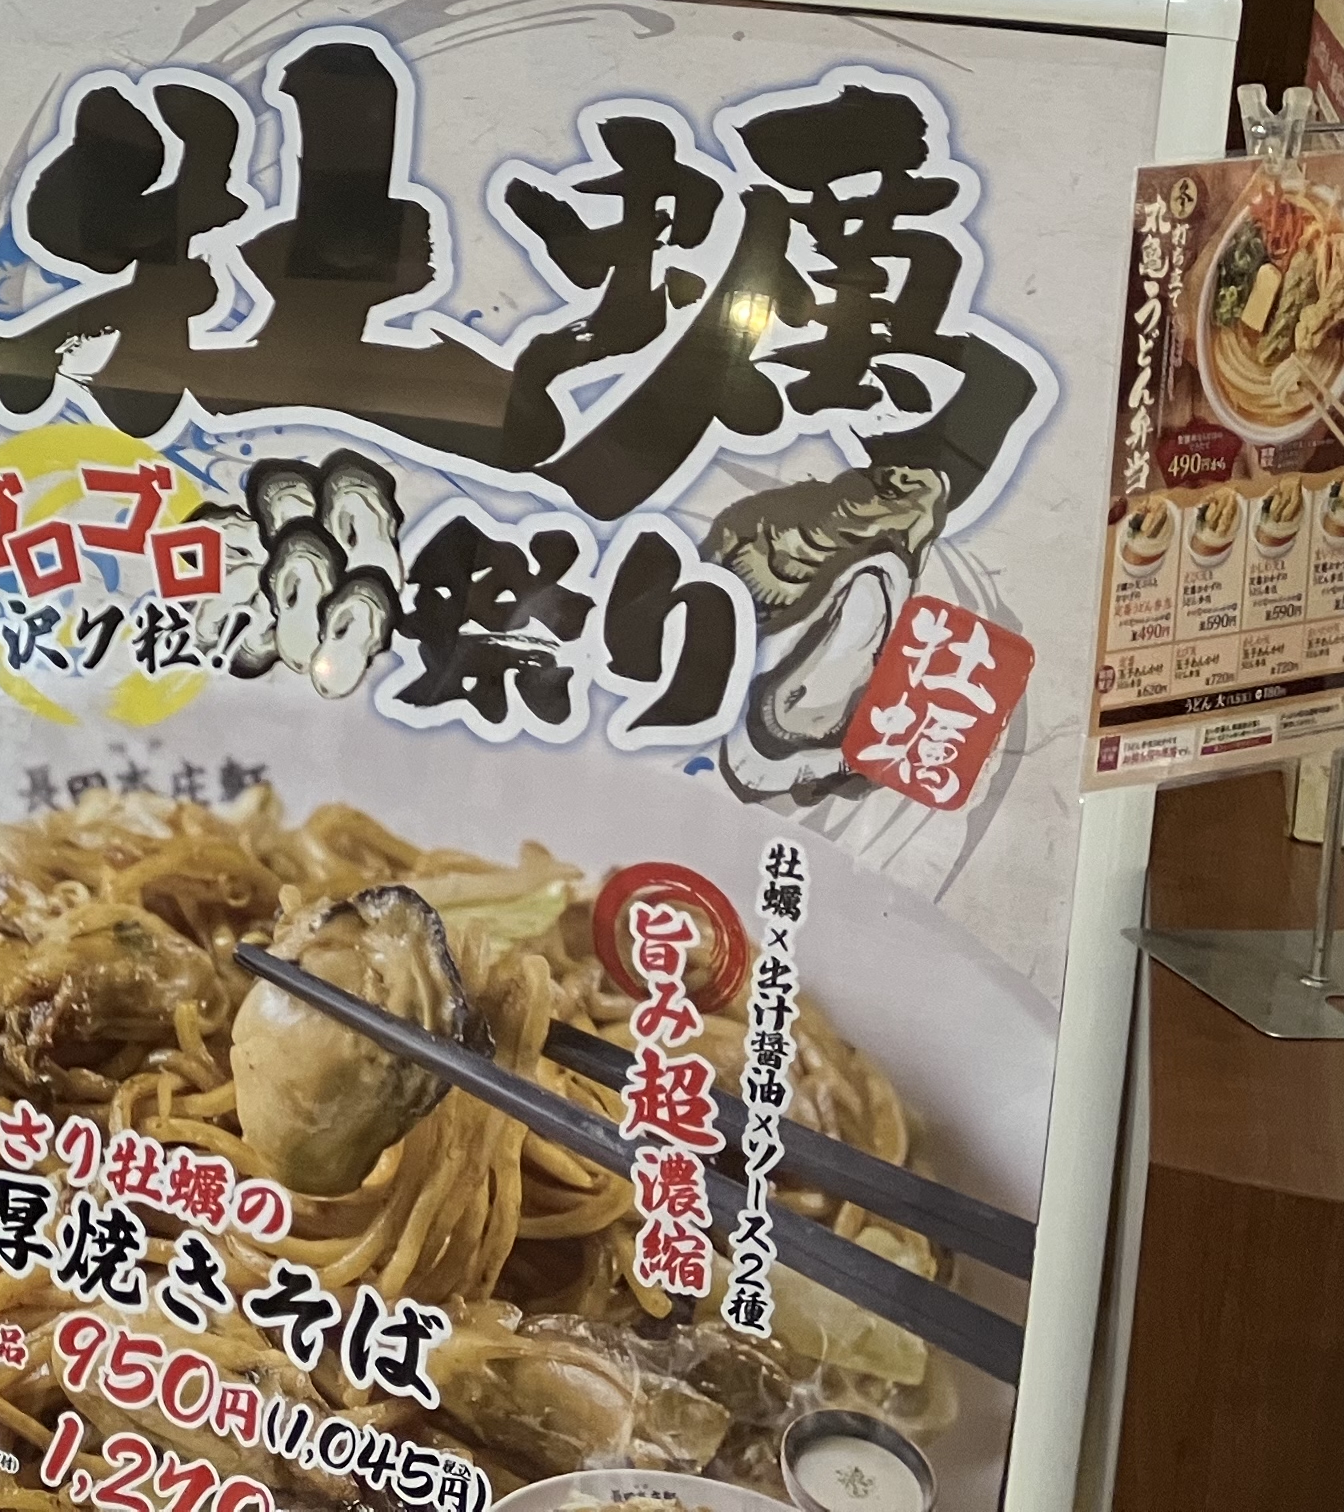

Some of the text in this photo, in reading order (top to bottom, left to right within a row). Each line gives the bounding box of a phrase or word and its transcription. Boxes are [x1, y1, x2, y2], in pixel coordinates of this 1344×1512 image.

[1124, 193, 1172, 495] 丸亀うどん弁当
[390, 515, 748, 734] 祭り
[853, 603, 1001, 812] 牡蠣
[624, 902, 720, 1292] 旨み超濃縮
